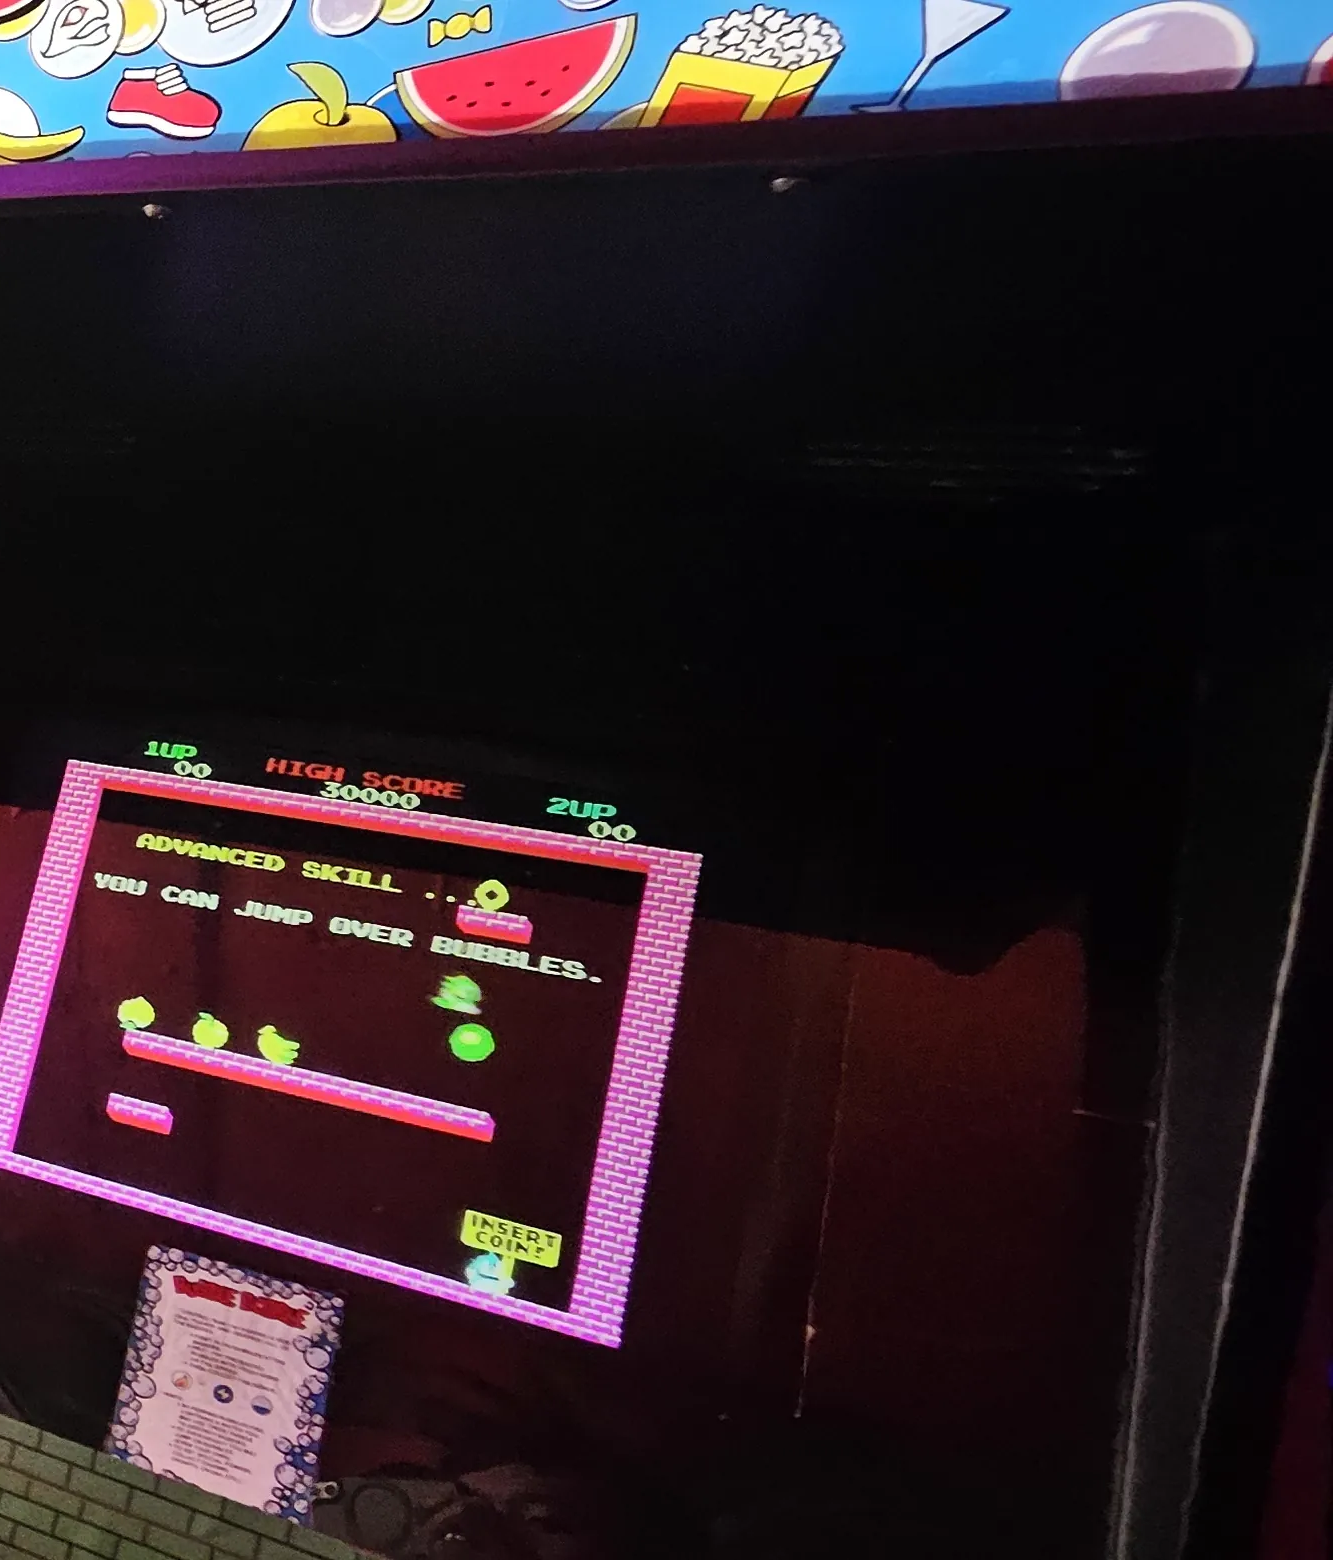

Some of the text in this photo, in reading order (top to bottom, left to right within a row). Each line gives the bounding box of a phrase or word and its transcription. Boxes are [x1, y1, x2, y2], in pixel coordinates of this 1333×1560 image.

[144, 741, 198, 759] 1UP
[173, 760, 213, 778] 00
[265, 757, 466, 800] HIGH SCORE
[320, 782, 421, 810] 30000
[546, 797, 617, 820] 2UP
[588, 820, 637, 842] 00
[135, 833, 286, 872] ADVANCED
[301, 860, 403, 894] SKILL
[94, 872, 603, 984] YOU CAN JUMP OVER BUBBLES.
[472, 1215, 557, 1248] INSERT
